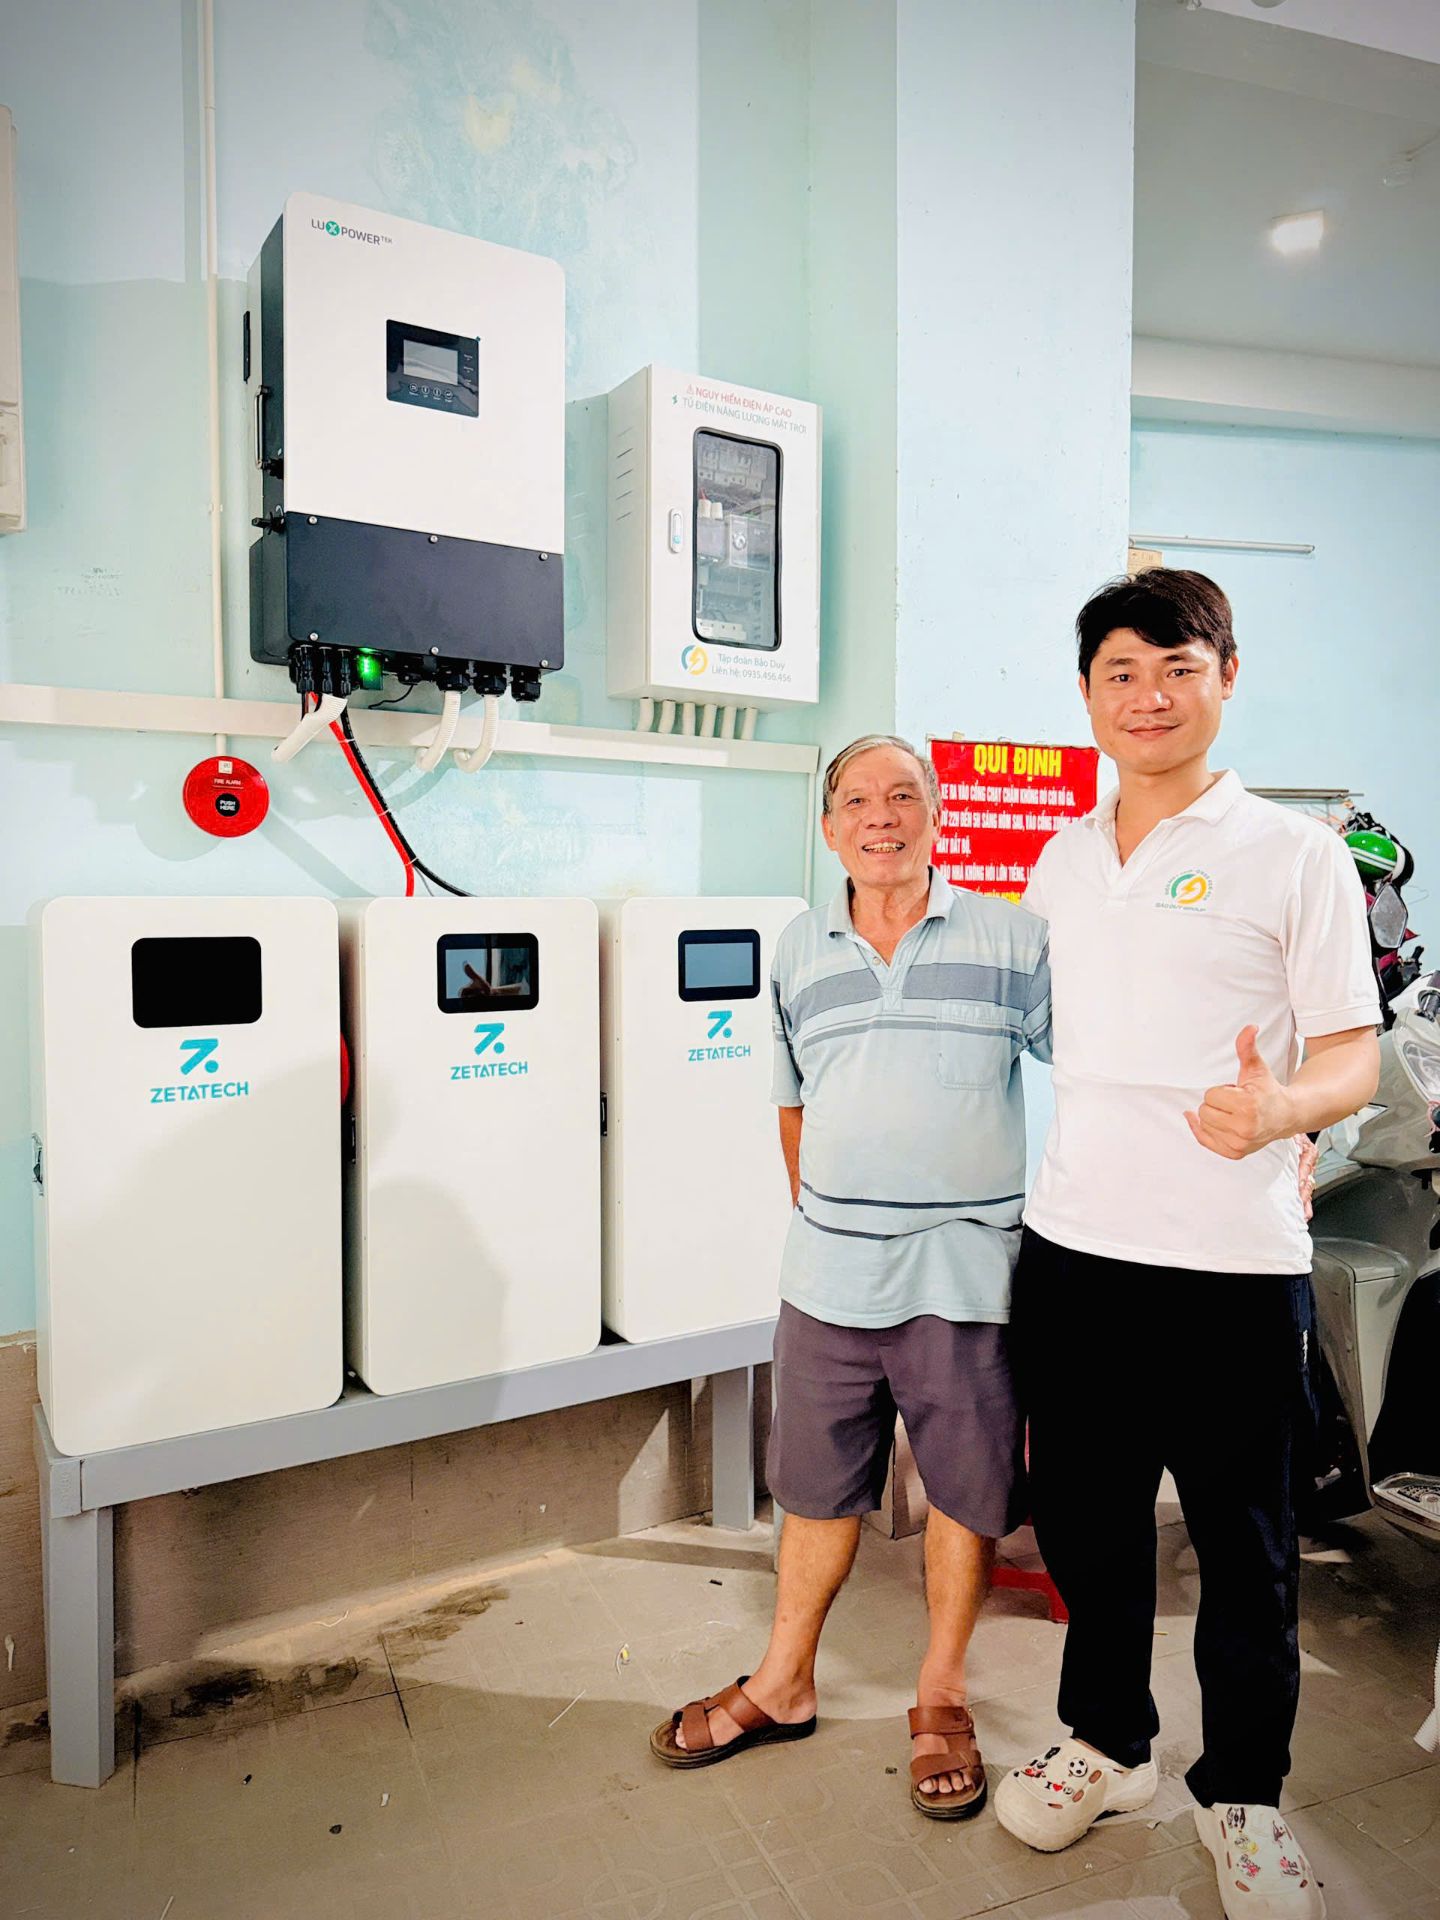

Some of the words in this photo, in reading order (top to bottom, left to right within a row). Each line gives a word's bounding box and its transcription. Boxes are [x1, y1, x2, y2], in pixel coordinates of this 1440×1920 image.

[696, 387, 719, 400] NGUY
[775, 406, 792, 418] CAO
[769, 659, 785, 671] Duy
[974, 743, 1008, 776] QUI
[1013, 746, 1062, 782] ĐỊNH
[1019, 785, 1039, 805] KHÔNG
[981, 809, 998, 829] SÁNG
[964, 861, 985, 882] KHÔNG
[688, 1044, 751, 1062] ZETATECH
[450, 1060, 529, 1081] ZETATECH
[150, 1081, 250, 1104] ZETATECH
